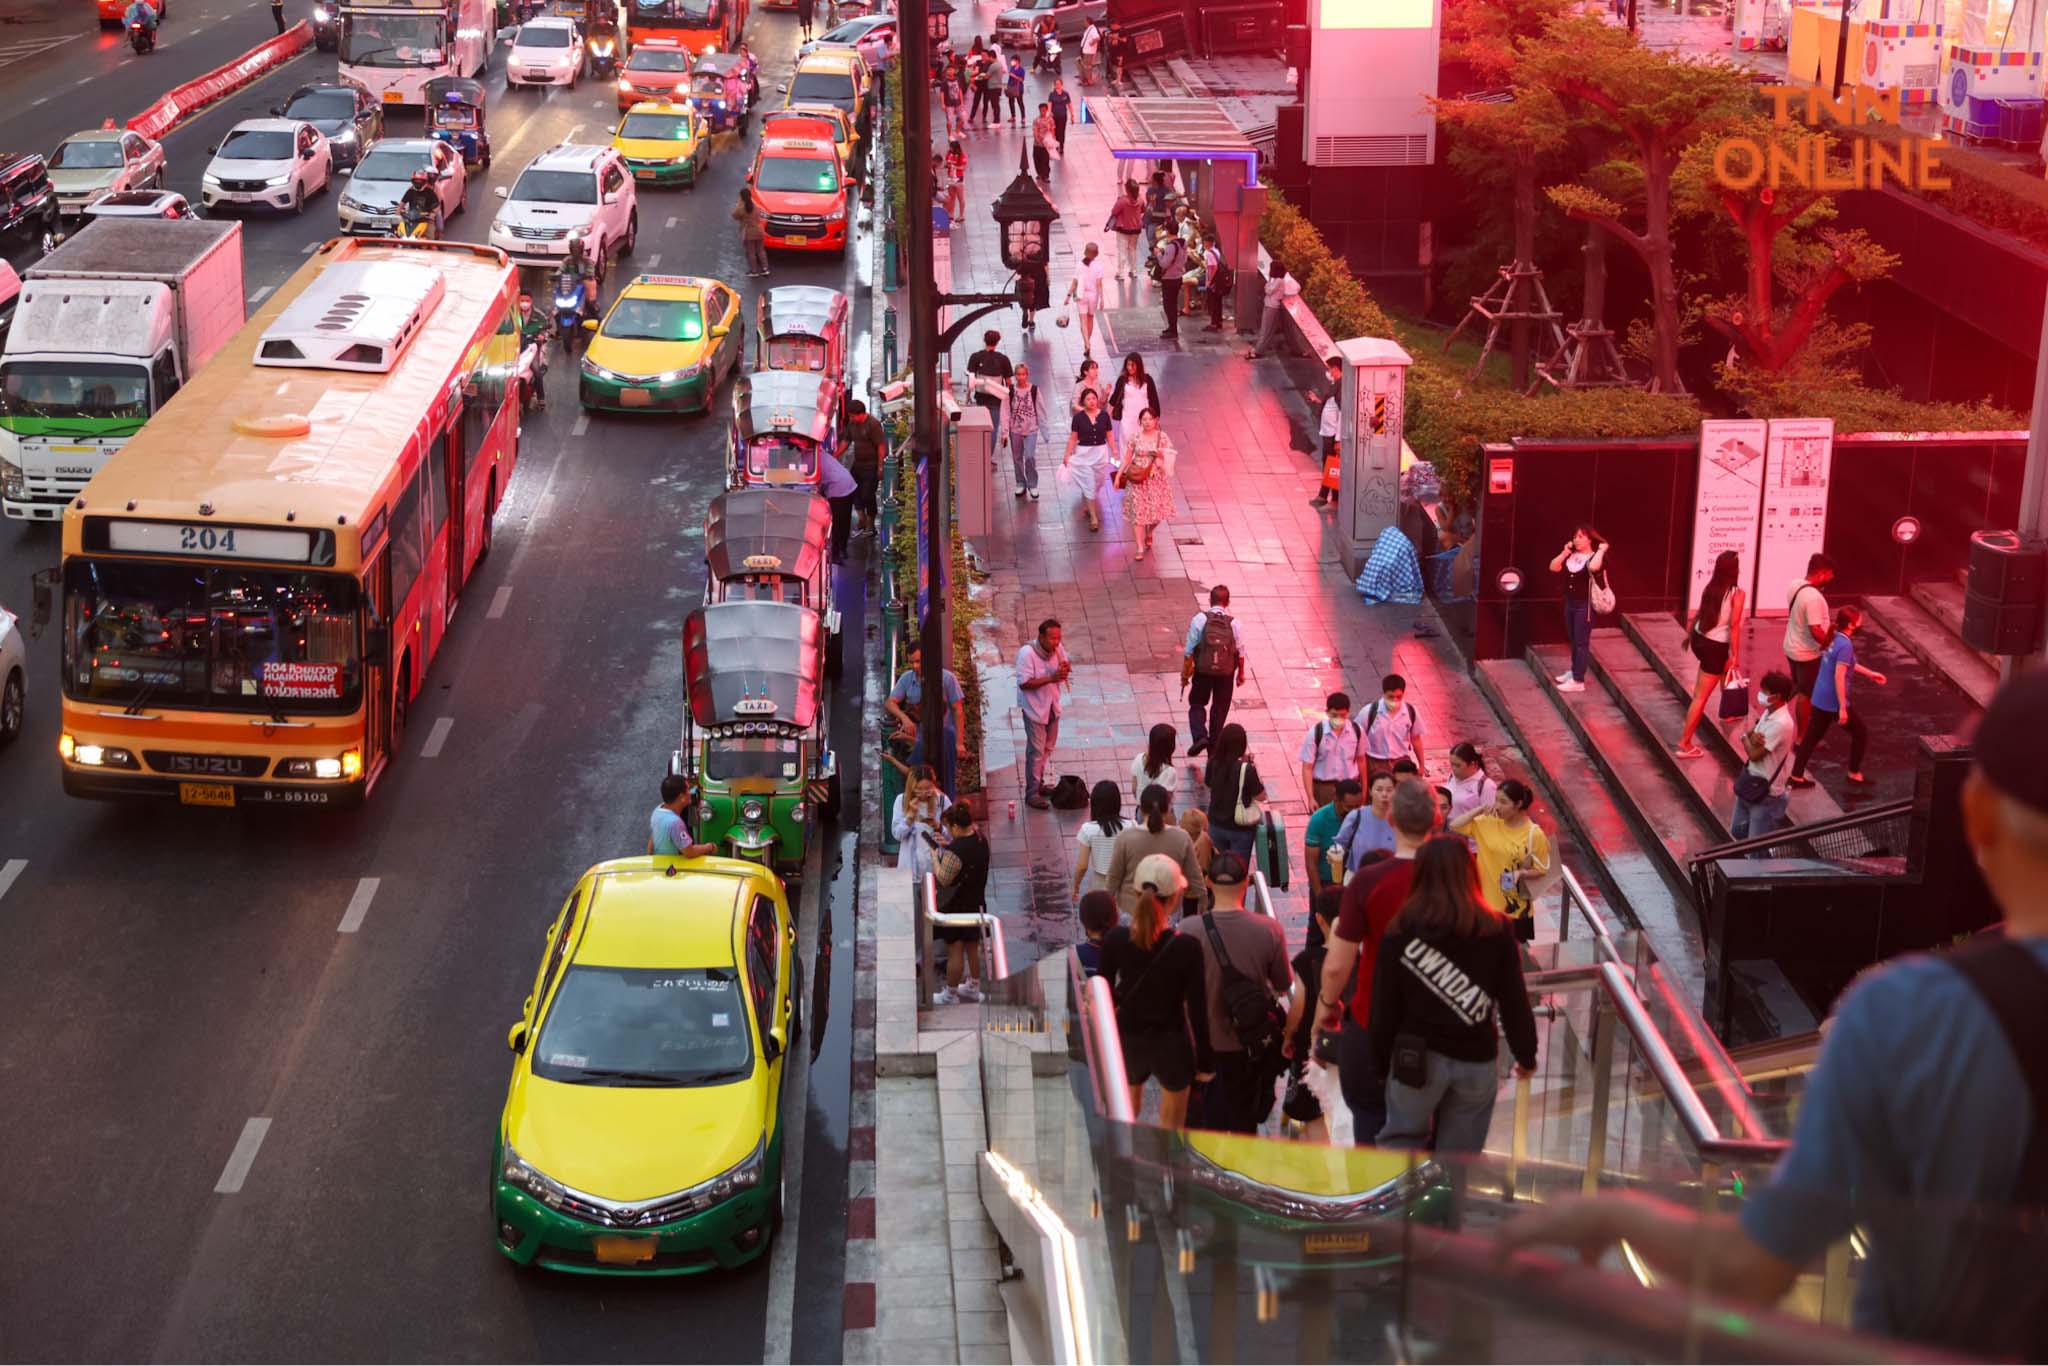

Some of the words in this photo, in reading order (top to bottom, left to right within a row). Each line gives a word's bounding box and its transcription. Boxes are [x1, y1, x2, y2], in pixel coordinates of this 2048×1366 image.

[55, 466, 93, 474] ISUZU
[180, 526, 238, 553] 204
[264, 662, 287, 673] 204
[263, 672, 336, 683] HUAIKHWANG
[743, 702, 768, 710] TAXI
[168, 755, 243, 773] ISUZU
